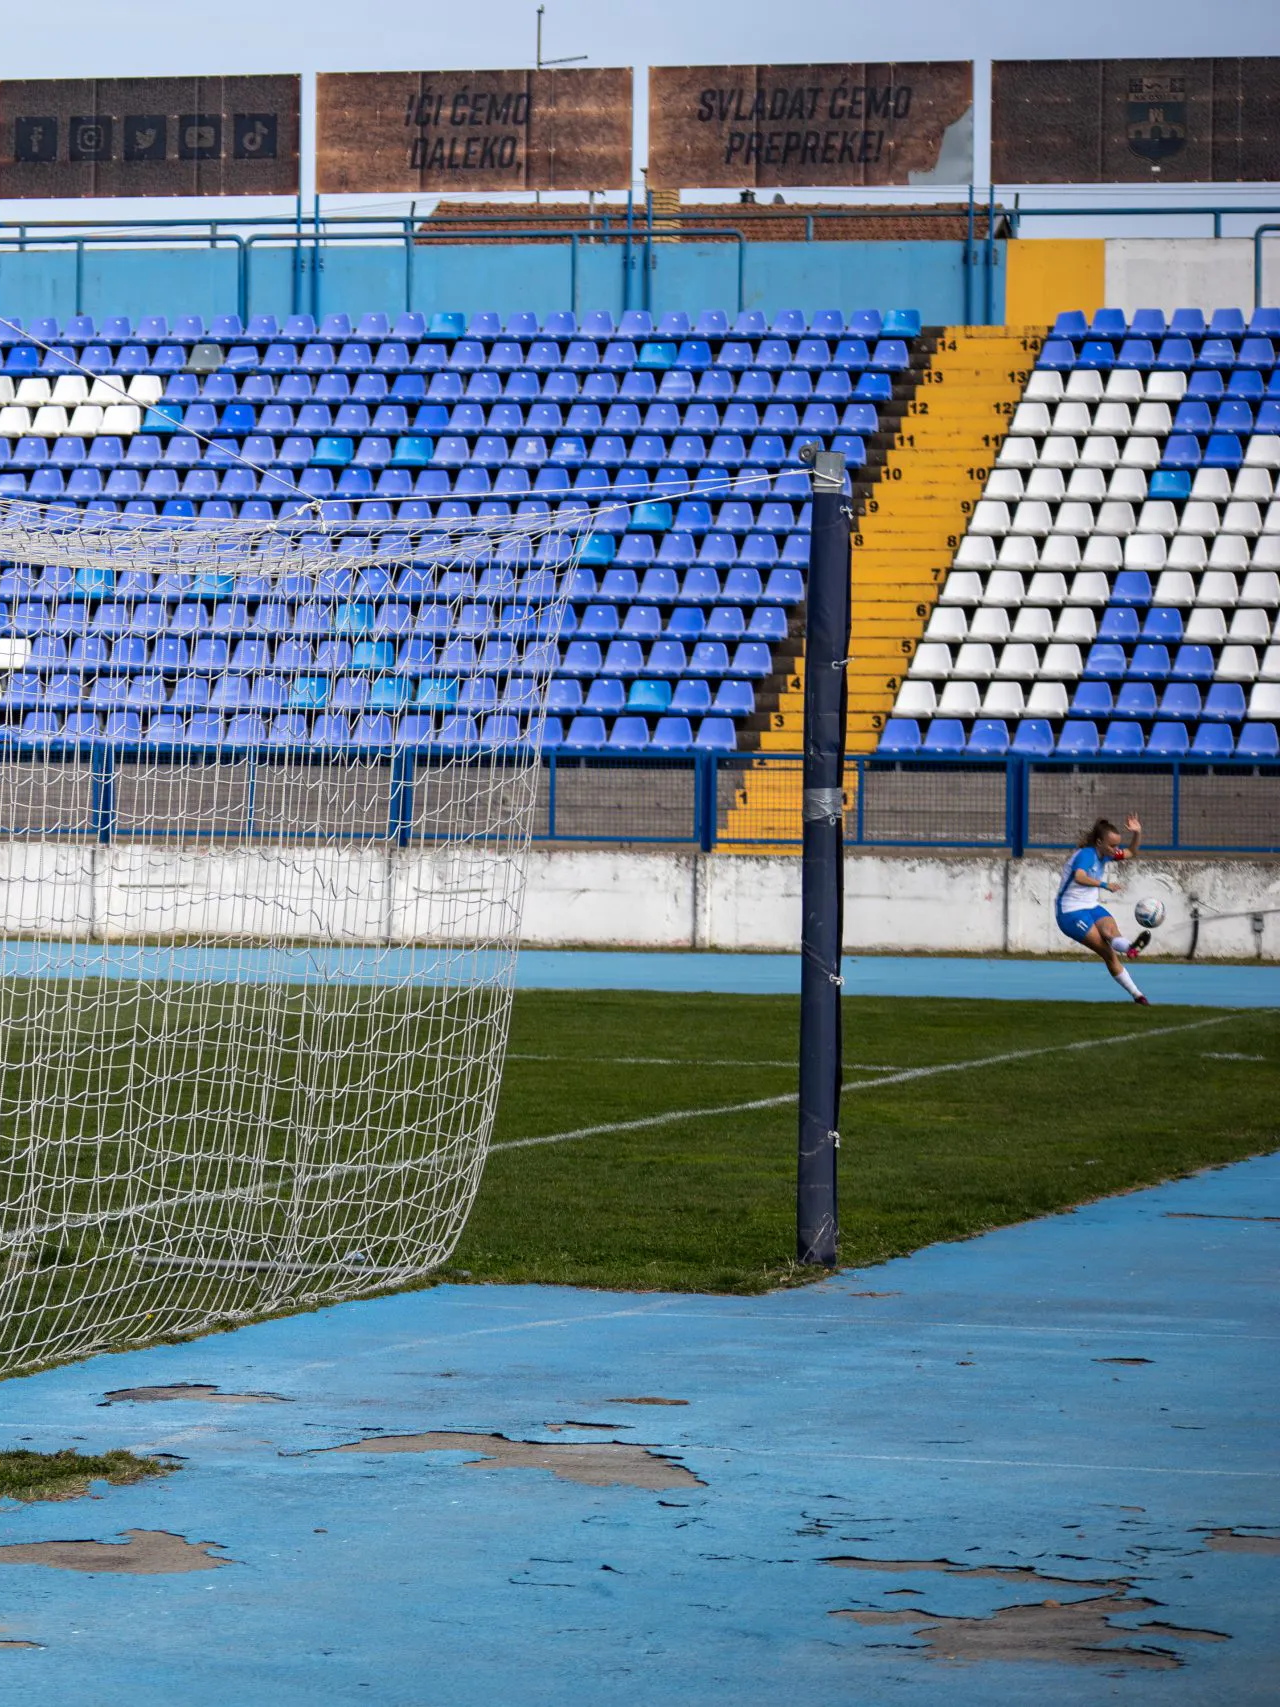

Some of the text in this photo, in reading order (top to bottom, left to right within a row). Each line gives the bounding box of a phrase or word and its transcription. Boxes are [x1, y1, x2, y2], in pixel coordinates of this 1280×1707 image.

[404, 85, 531, 126] IĆI ĆEMO
[697, 79, 912, 122] SVLADAT ĆEMO
[725, 130, 884, 165] PREPREKE!
[409, 136, 523, 174] DALEKO,
[939, 340, 957, 351] 14
[1020, 340, 1040, 351] 14
[924, 371, 943, 383] 13
[1008, 371, 1026, 383] 13
[910, 402, 928, 414] 12
[993, 402, 1012, 414] 12
[897, 435, 915, 446] 11
[982, 435, 1000, 446] 11
[884, 468, 902, 480] 10
[967, 468, 985, 480] 10
[869, 501, 878, 513] 9
[961, 501, 970, 513] 9
[854, 534, 863, 546] 8
[947, 535, 957, 547] 8
[931, 568, 941, 581] 7
[916, 603, 926, 617] 6
[902, 640, 911, 653] 5
[791, 677, 801, 690] 4
[887, 677, 897, 690] 4
[774, 715, 784, 727] 3
[872, 715, 882, 728] 3
